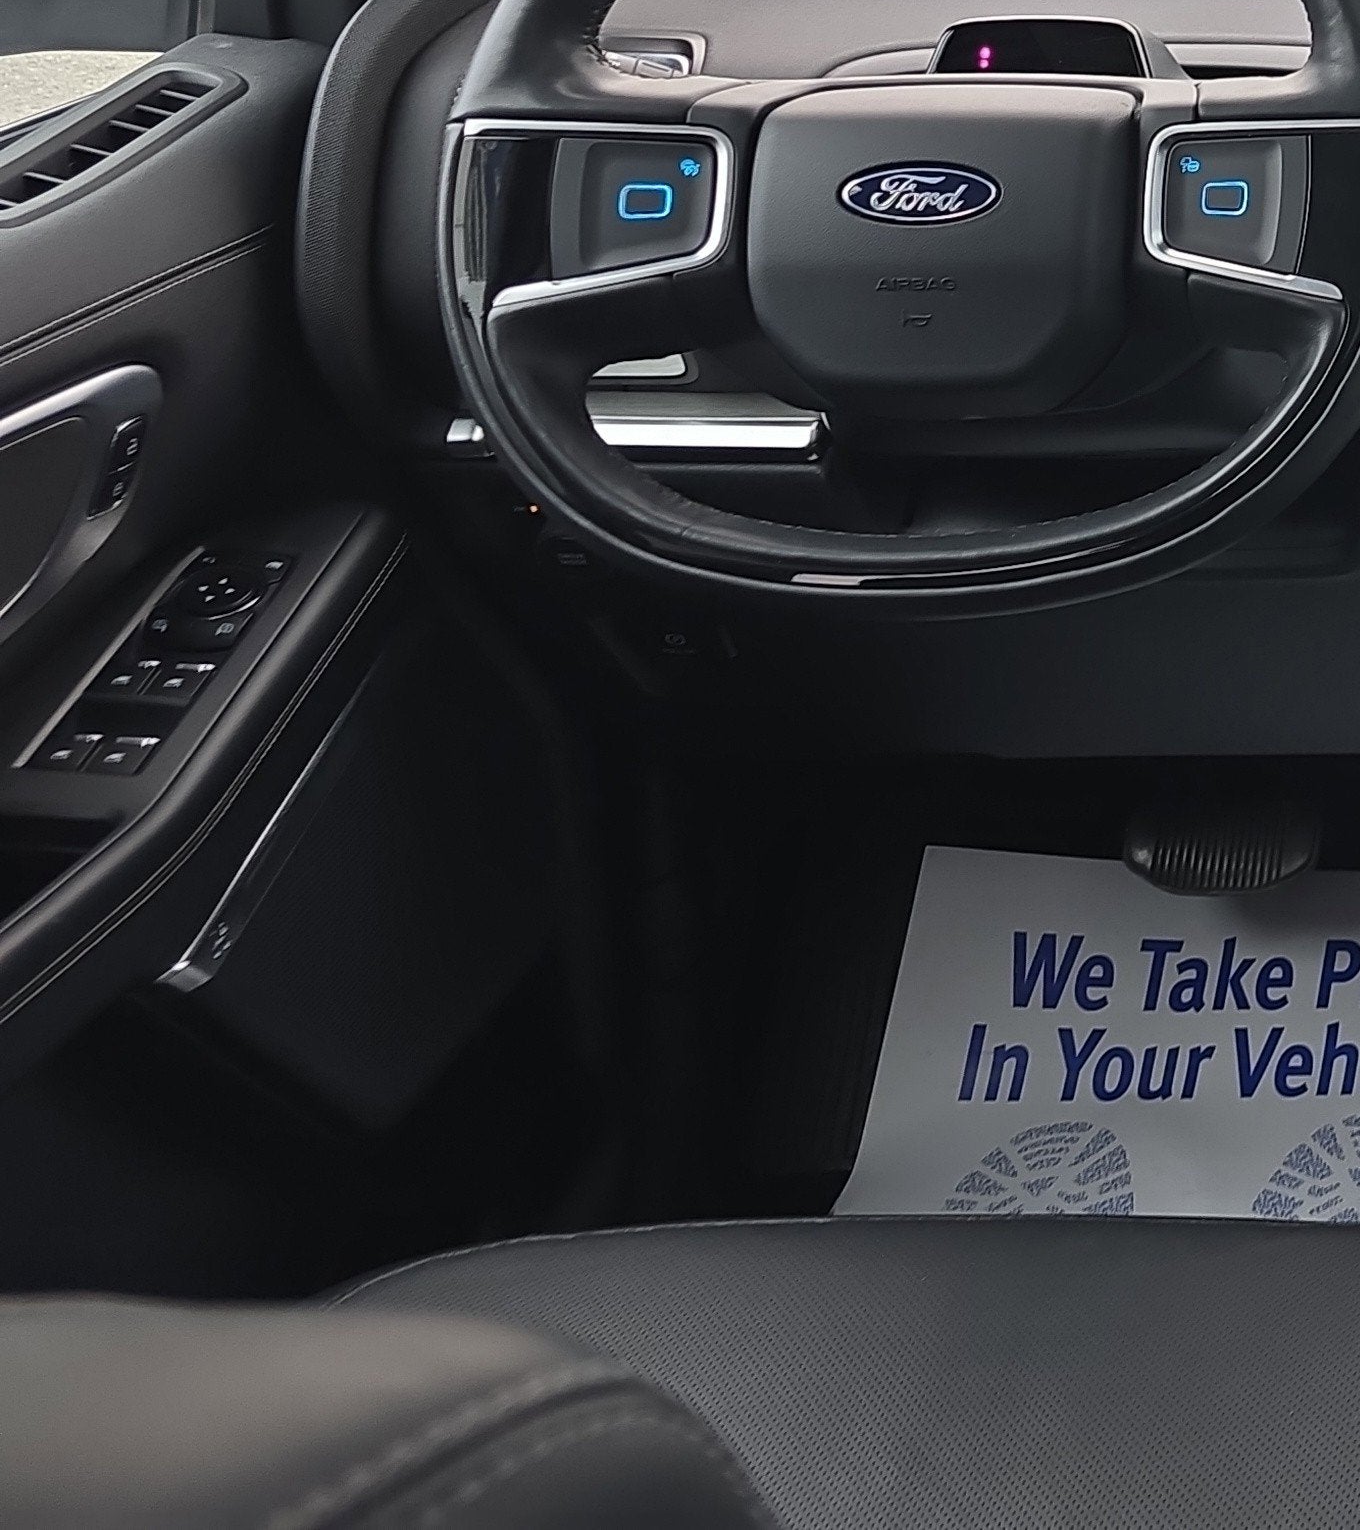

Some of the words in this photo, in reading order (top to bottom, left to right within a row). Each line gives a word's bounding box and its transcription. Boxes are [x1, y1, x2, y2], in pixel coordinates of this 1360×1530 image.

[869, 173, 969, 213] Ford
[875, 276, 957, 293] AIRBAG
[1011, 930, 1115, 1012] We
[1139, 936, 1294, 1013] Take
[958, 1022, 1030, 1102] In
[1056, 1025, 1215, 1102] Your
